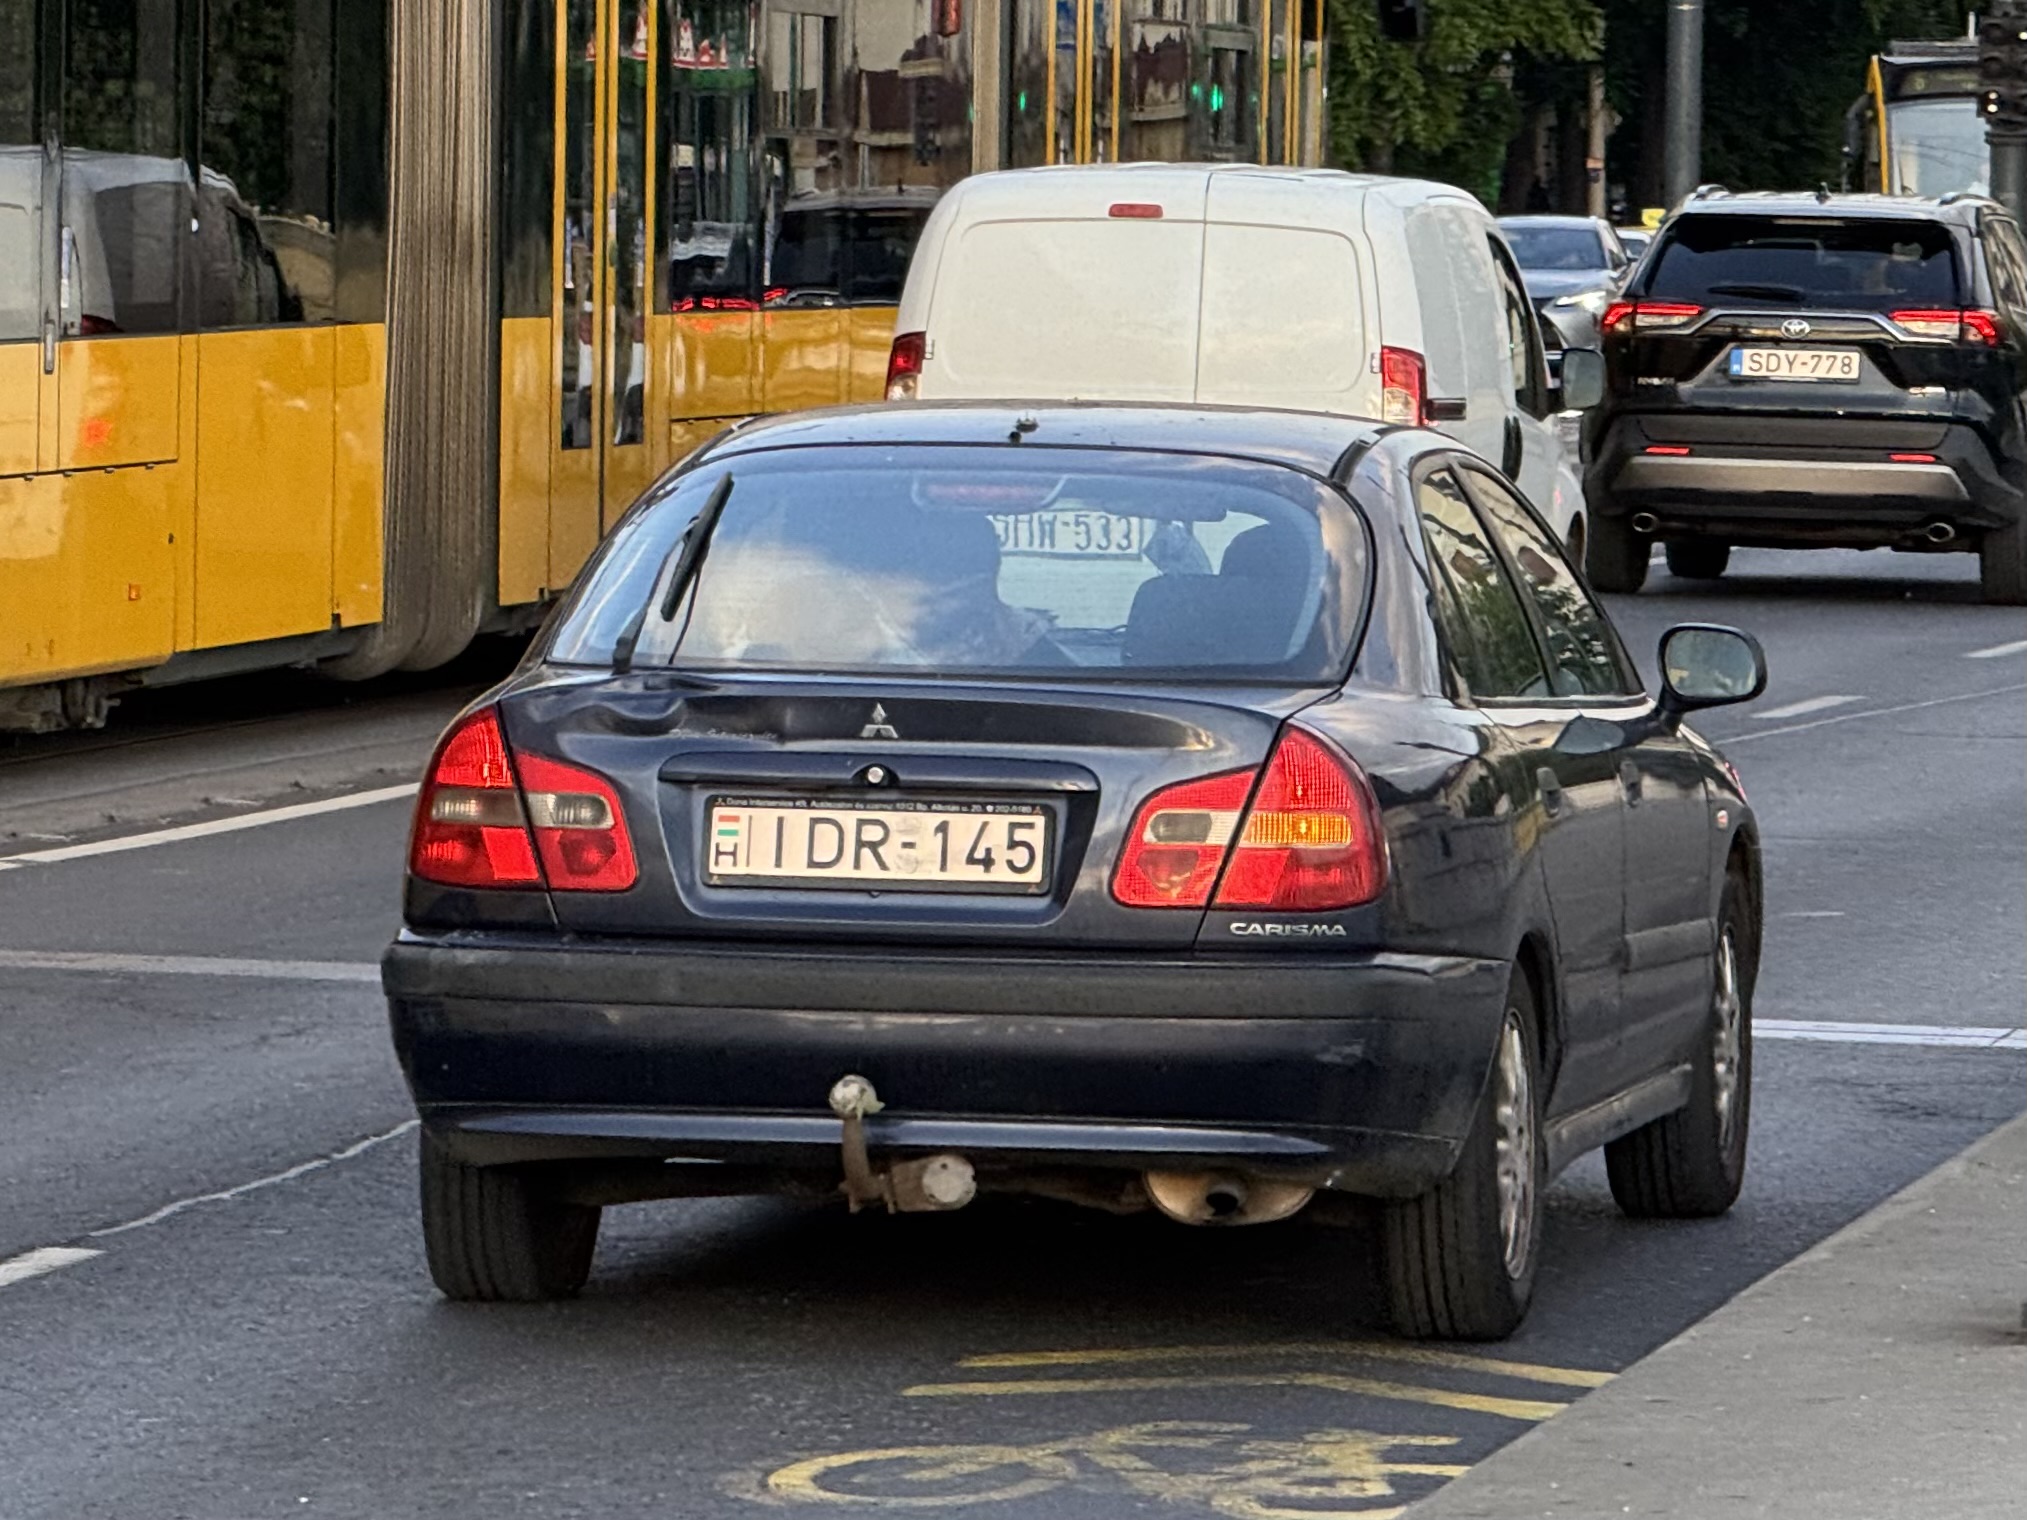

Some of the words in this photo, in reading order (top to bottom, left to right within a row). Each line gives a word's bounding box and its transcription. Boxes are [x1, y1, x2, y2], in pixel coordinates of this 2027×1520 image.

[1748, 352, 1852, 375] SDY-778
[714, 841, 739, 867] H
[773, 815, 1037, 874] IDR-145
[1229, 922, 1347, 937] CARISMA
